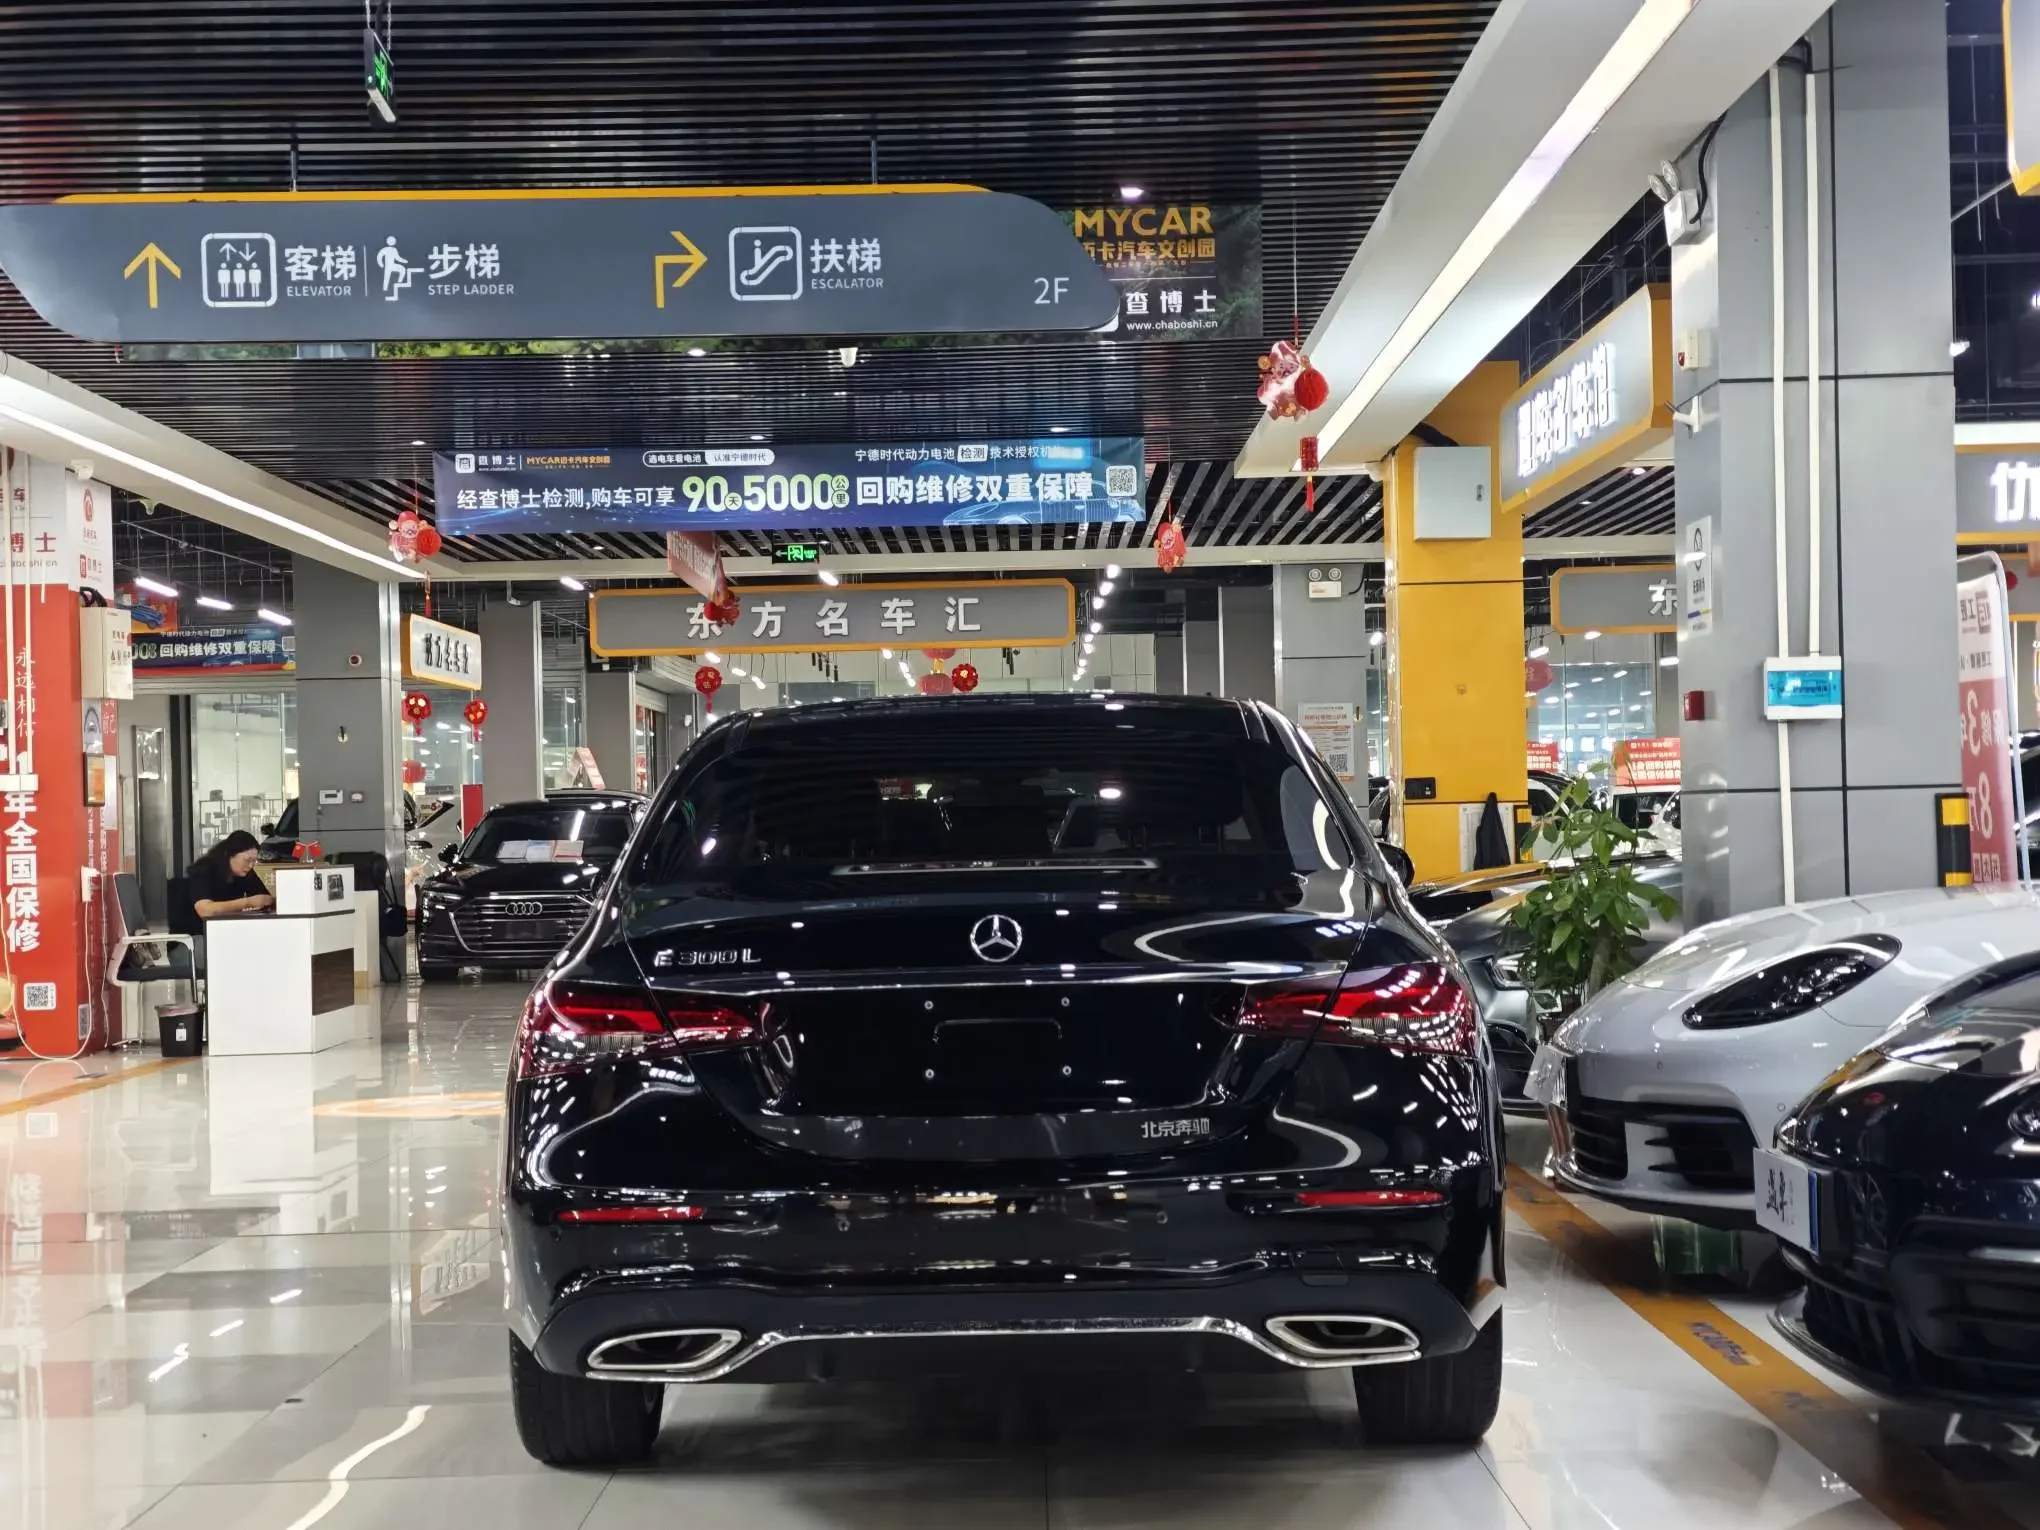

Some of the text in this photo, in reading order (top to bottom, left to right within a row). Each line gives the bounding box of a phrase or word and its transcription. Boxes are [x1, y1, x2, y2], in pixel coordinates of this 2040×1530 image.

[1074, 203, 1214, 237] MYCAR
[284, 244, 357, 281] 客梯
[427, 243, 501, 280] 步梯
[810, 237, 882, 275] 扶梯
[286, 286, 352, 297] ELEVATOR
[428, 284, 515, 295] STEP LADDER
[811, 277, 884, 290] ESCALATOR
[1034, 277, 1070, 304] 2F
[1125, 289, 1217, 315] 查博士
[1126, 318, 1218, 331] www.chaboshi.cn
[856, 471, 1098, 506] 回购维修双重保障
[685, 595, 982, 639] 东方名车汇
[159, 639, 276, 658] 回购维修双重保障
[653, 948, 674, 968] E
[742, 947, 762, 964] L
[1140, 1117, 1210, 1138] 北京奔驰
